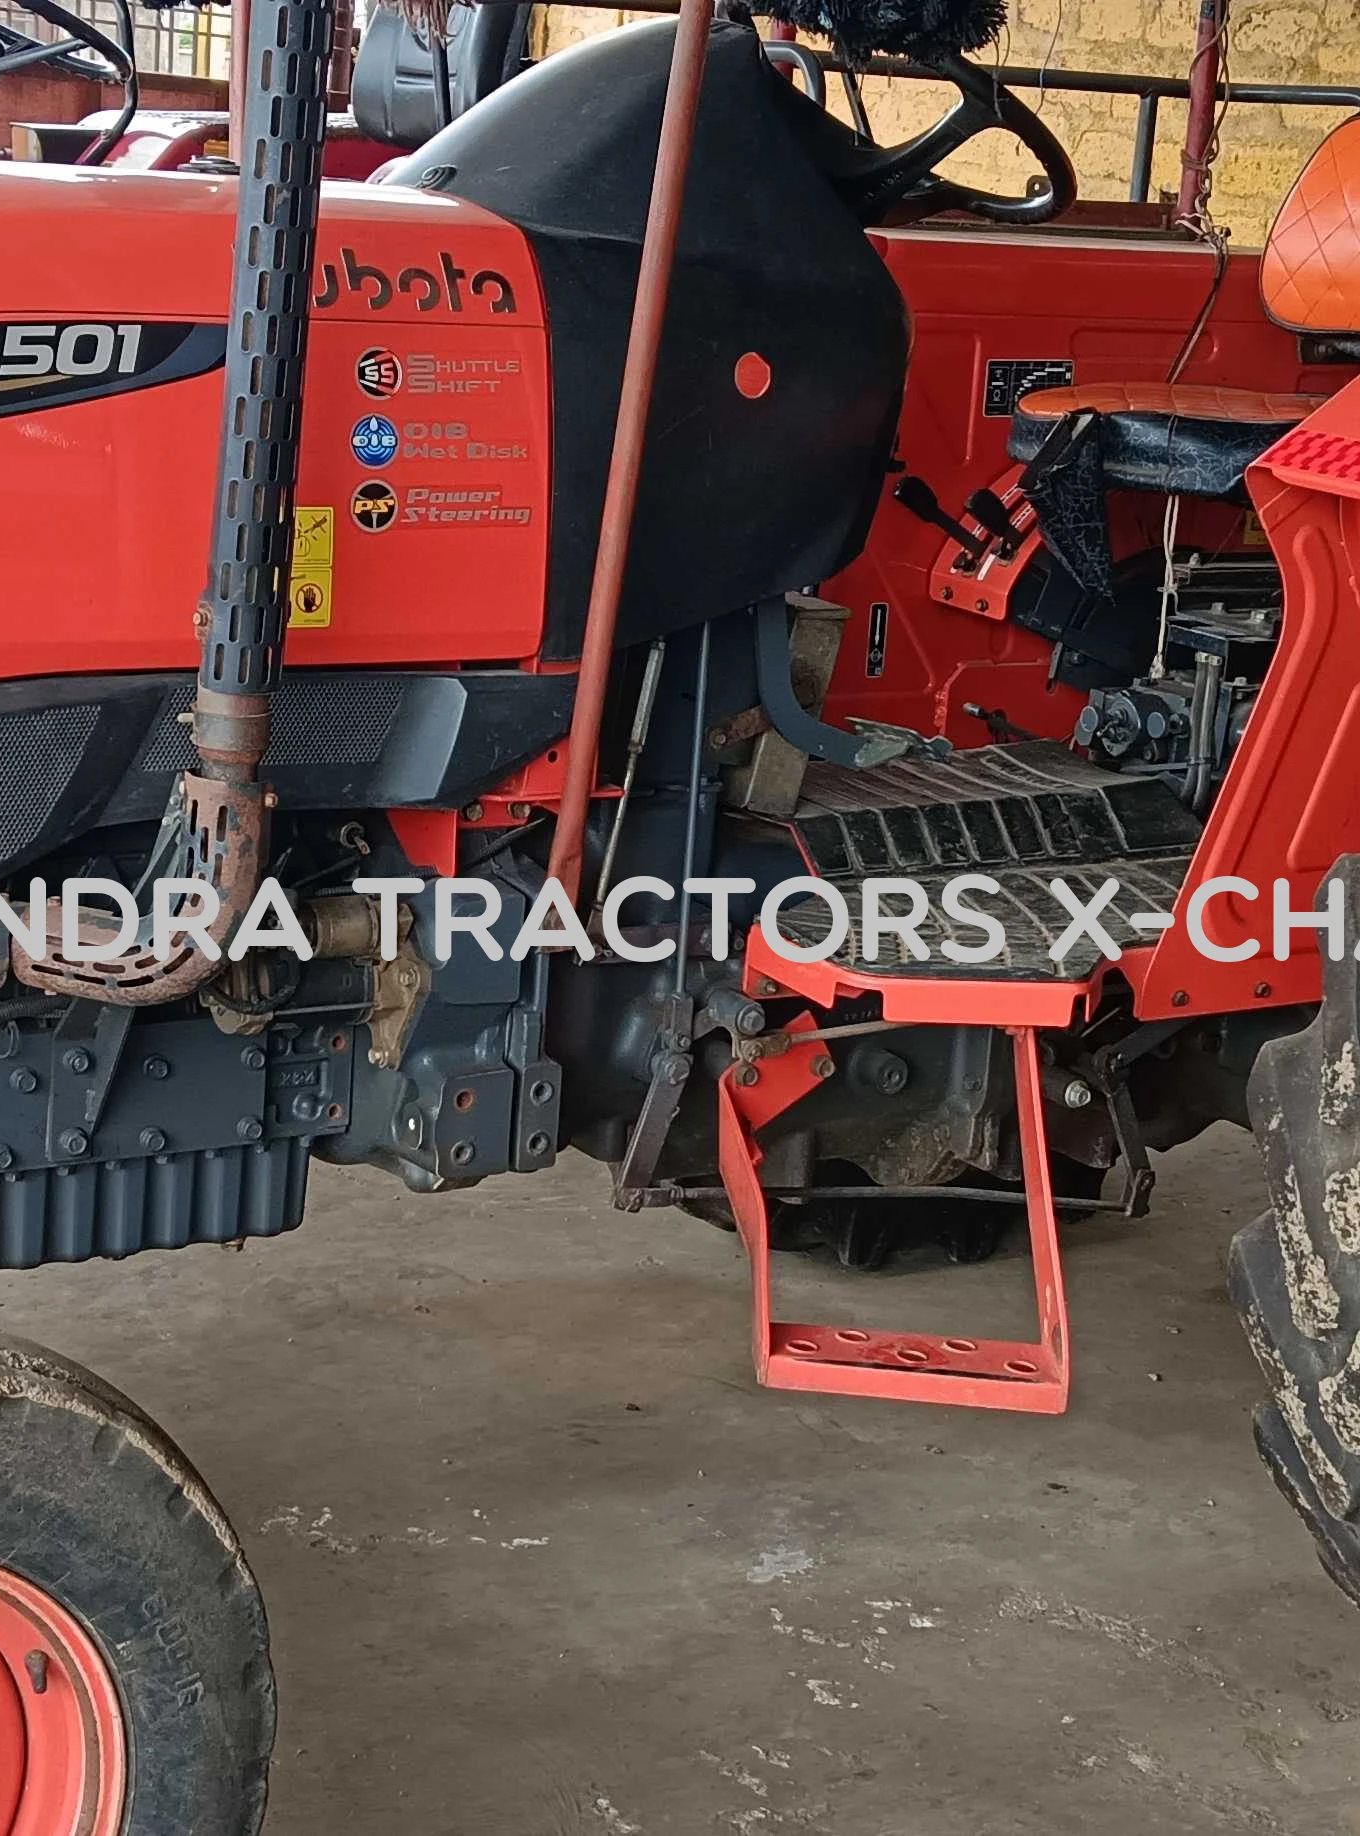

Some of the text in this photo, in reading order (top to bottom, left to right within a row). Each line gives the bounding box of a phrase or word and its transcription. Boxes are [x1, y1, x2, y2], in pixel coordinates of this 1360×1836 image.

[313, 247, 518, 313] ubota
[404, 442, 528, 460] Wet Disk
[407, 488, 501, 504] Power
[400, 505, 532, 524] Steering
